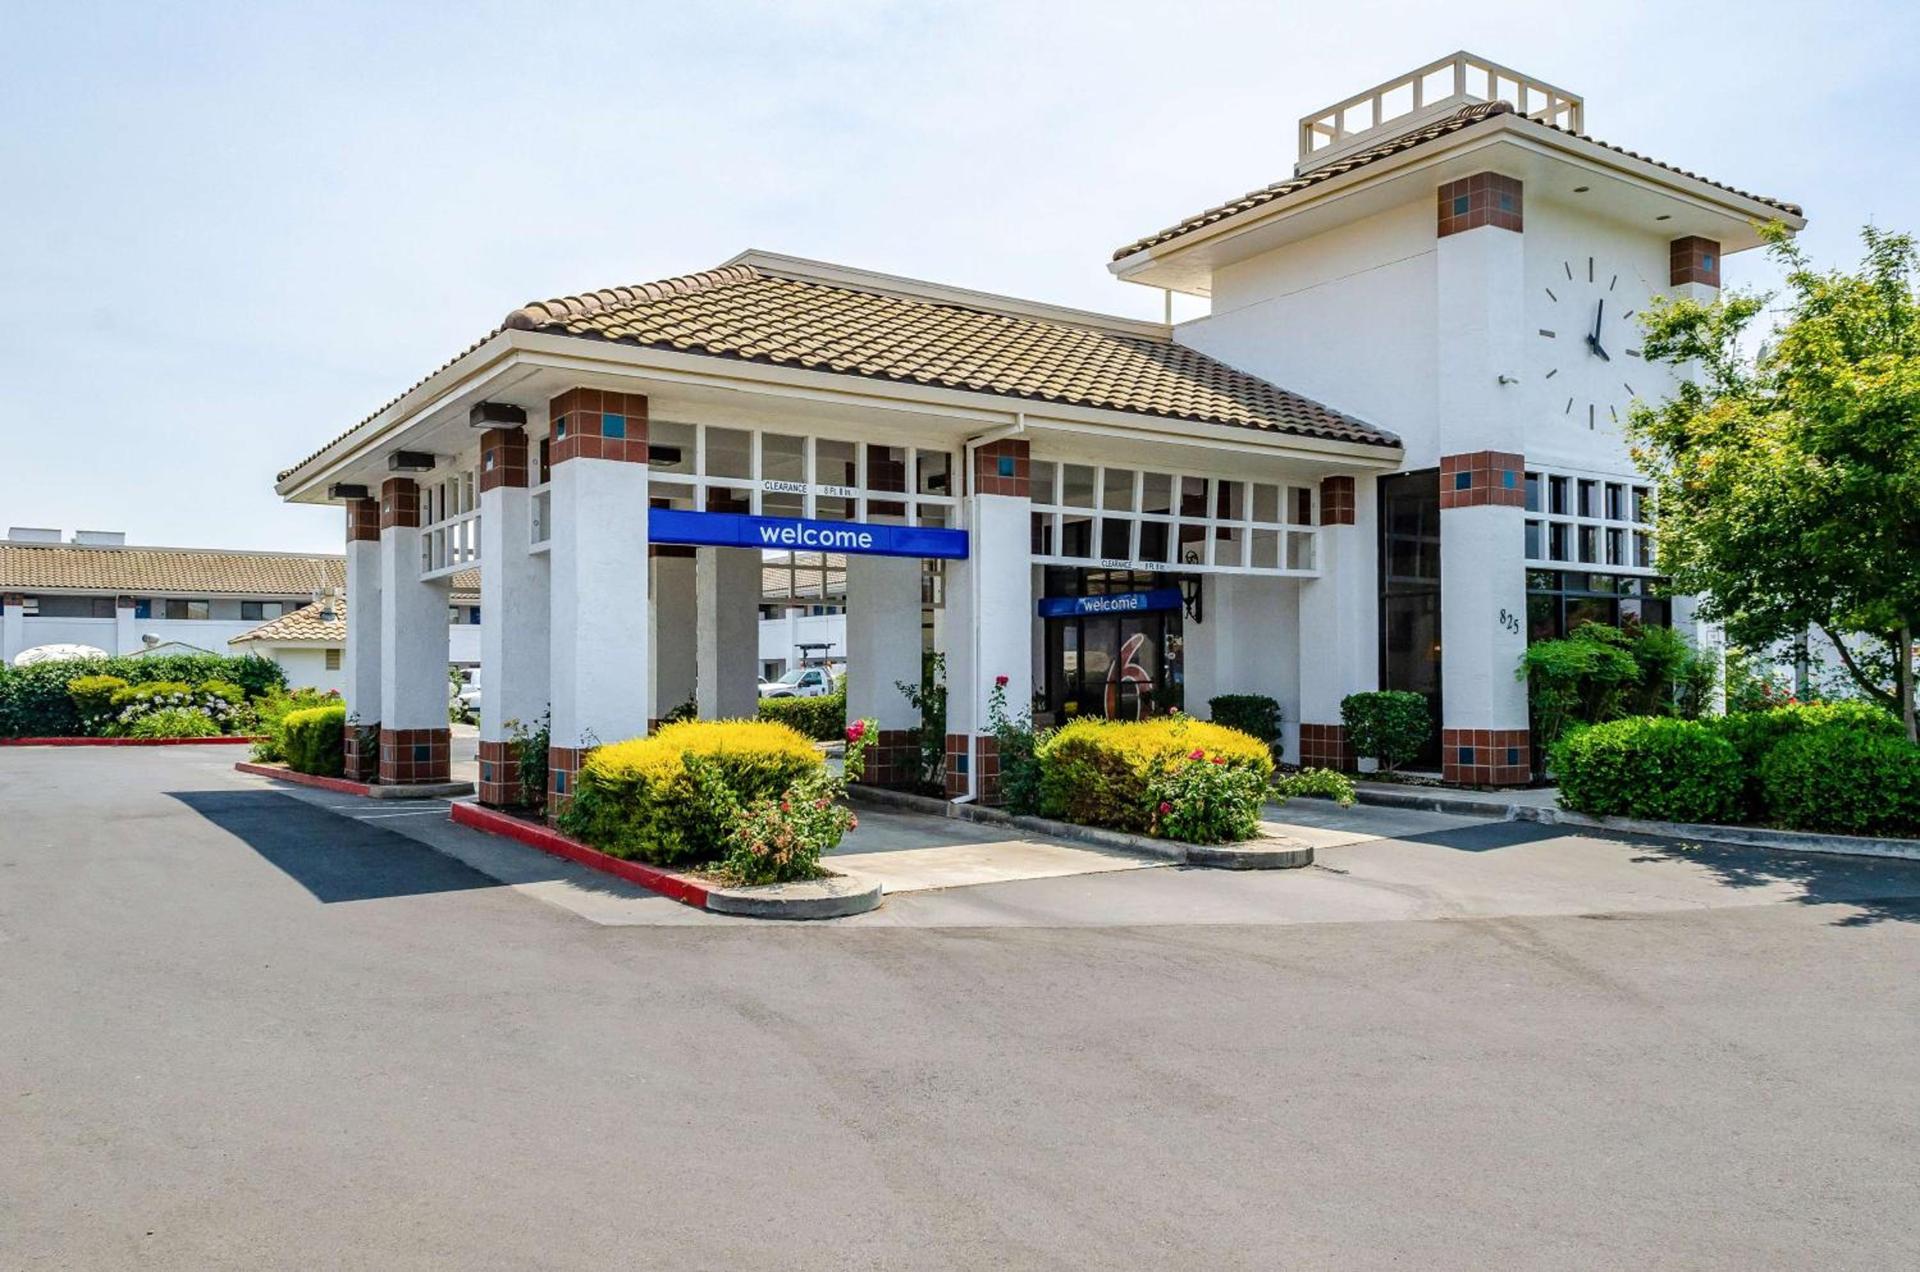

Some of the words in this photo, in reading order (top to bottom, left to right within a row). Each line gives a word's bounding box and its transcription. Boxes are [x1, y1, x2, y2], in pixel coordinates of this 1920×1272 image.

[764, 481, 808, 493] CLEARANCE
[760, 524, 872, 548] welcome
[1085, 597, 1138, 612] welcome
[1500, 608, 1519, 635] 825
